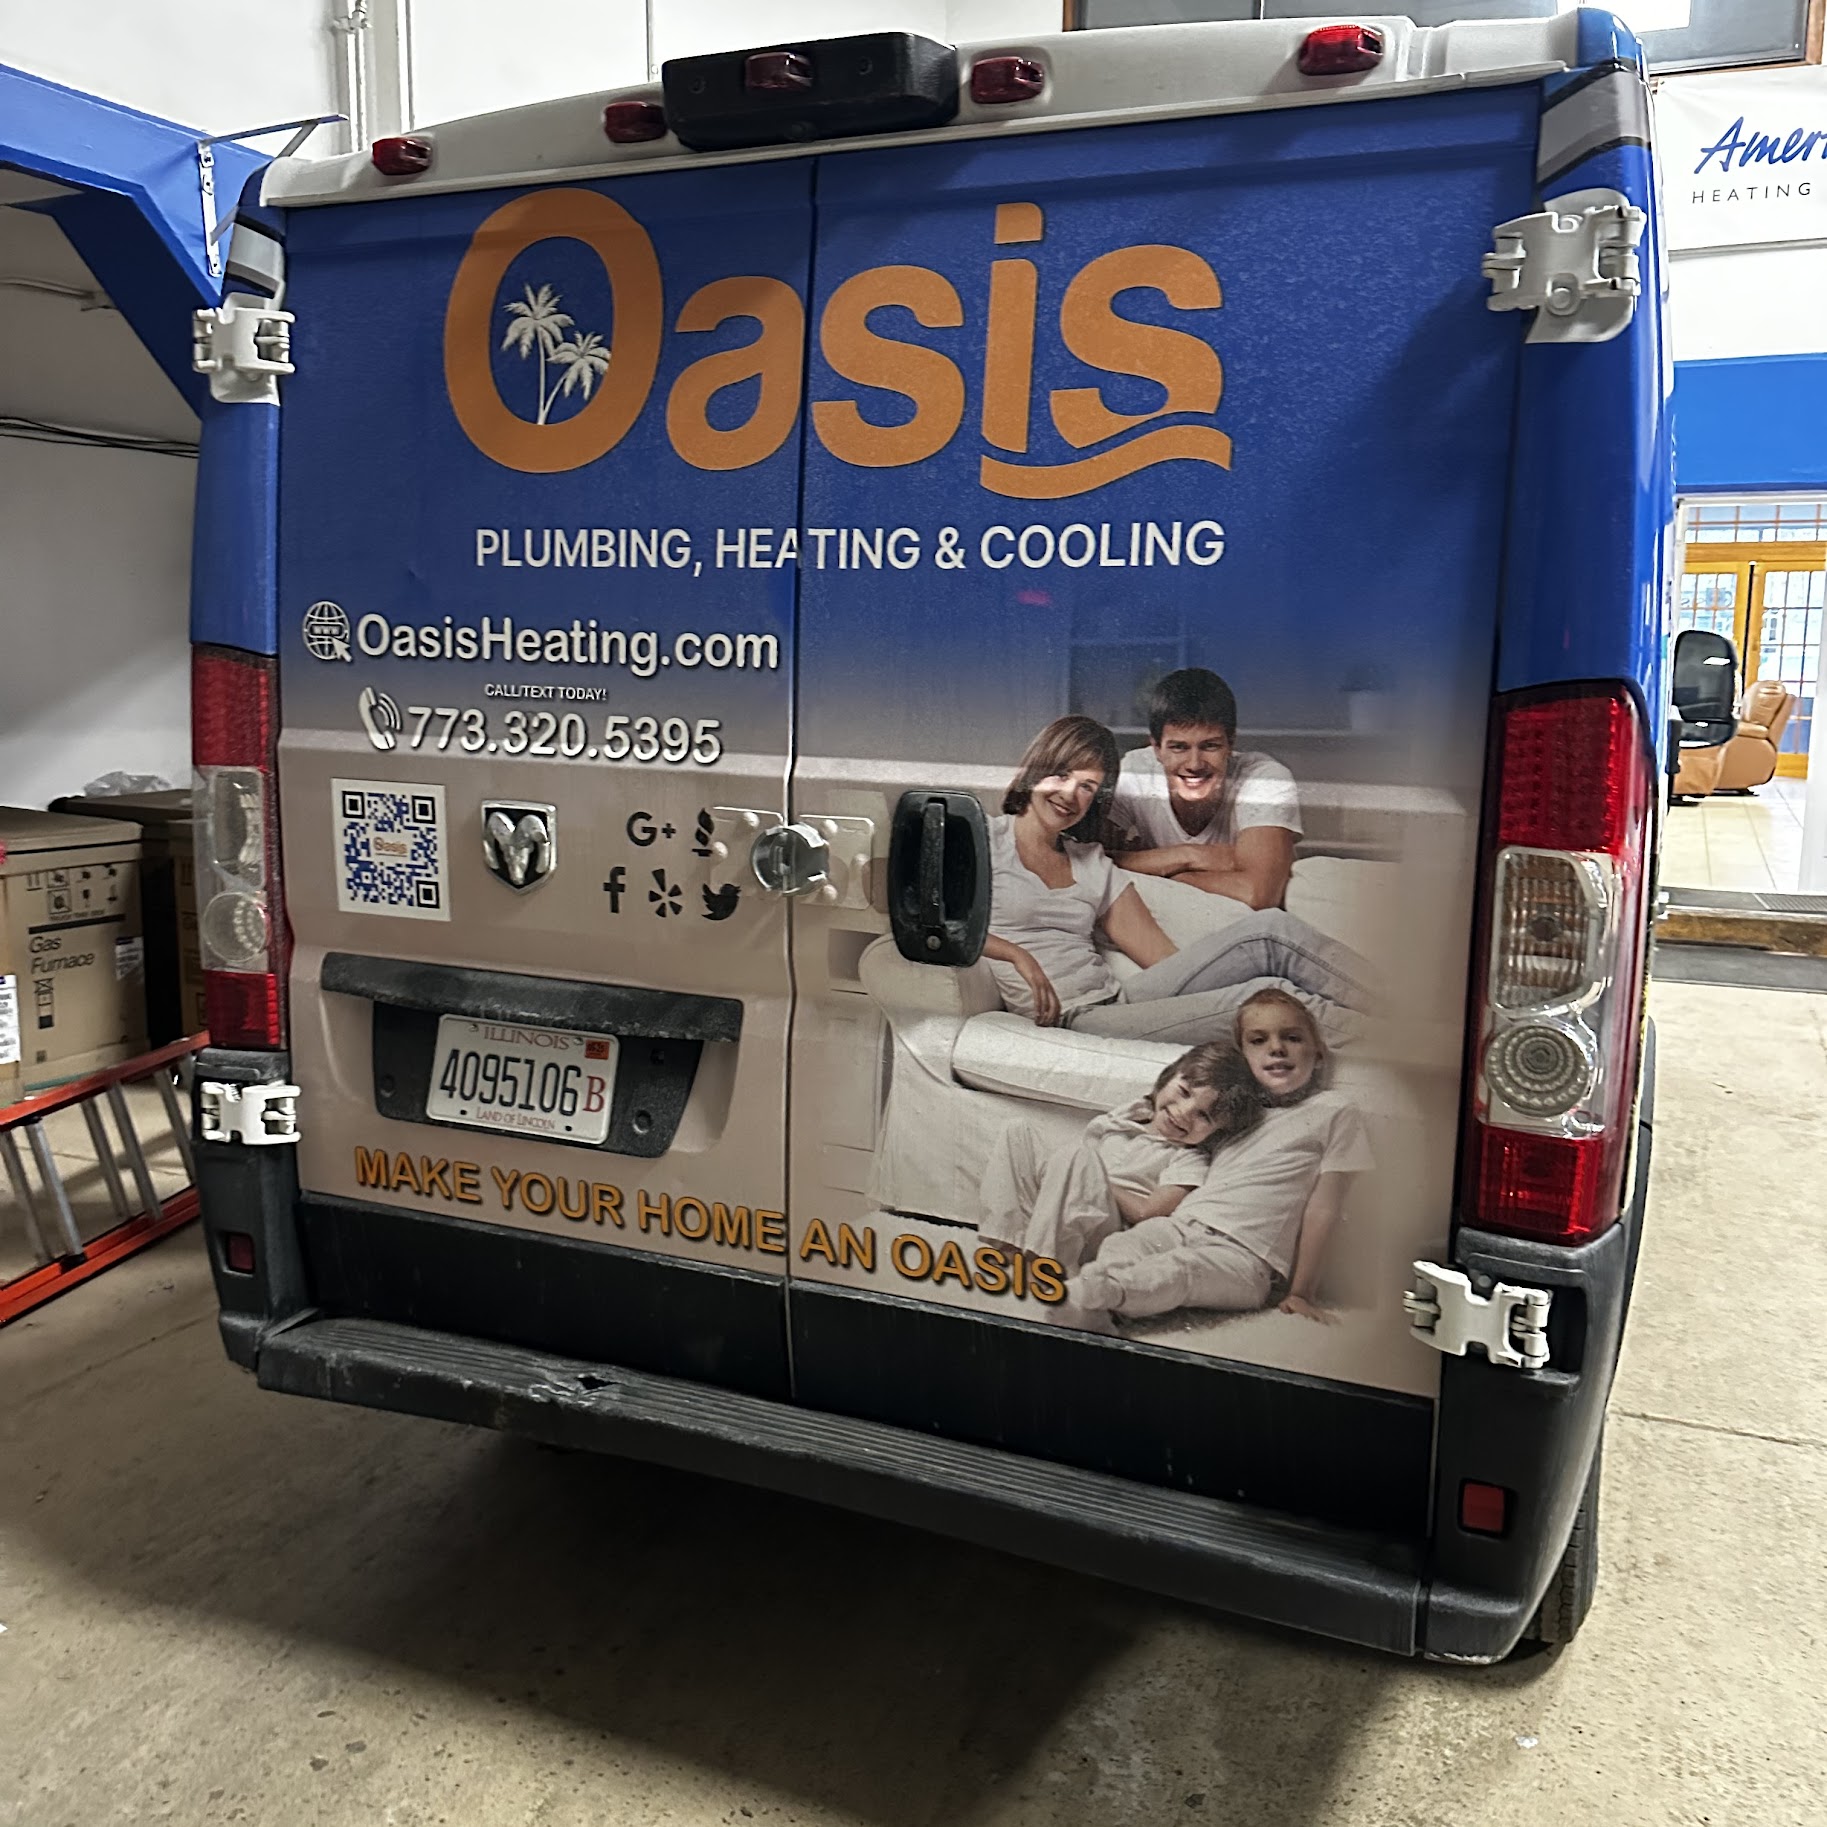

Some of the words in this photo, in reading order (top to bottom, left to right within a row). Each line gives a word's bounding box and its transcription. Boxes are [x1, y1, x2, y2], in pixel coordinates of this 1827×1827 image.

[1692, 183, 1811, 204] HEATING
[444, 188, 1232, 499] Oasis
[476, 528, 702, 577] PLUMBING,
[715, 527, 921, 570] HEATING
[934, 526, 966, 569] &
[980, 520, 1225, 569] COOLING
[357, 613, 779, 677] OasisHeating.com
[557, 686, 607, 701] TODAY!
[407, 706, 722, 764] 773.320.5395
[30, 936, 62, 954] Gas
[31, 953, 95, 975] Furnace
[484, 1026, 570, 1050] ILLINOIS
[440, 1048, 582, 1117] 4095106
[582, 1075, 607, 1113] B
[354, 1145, 482, 1204] MAKE
[491, 1165, 624, 1227] YOUR
[637, 1189, 786, 1254] HOME
[800, 1218, 876, 1273] AN
[890, 1233, 1068, 1304] OASIS
